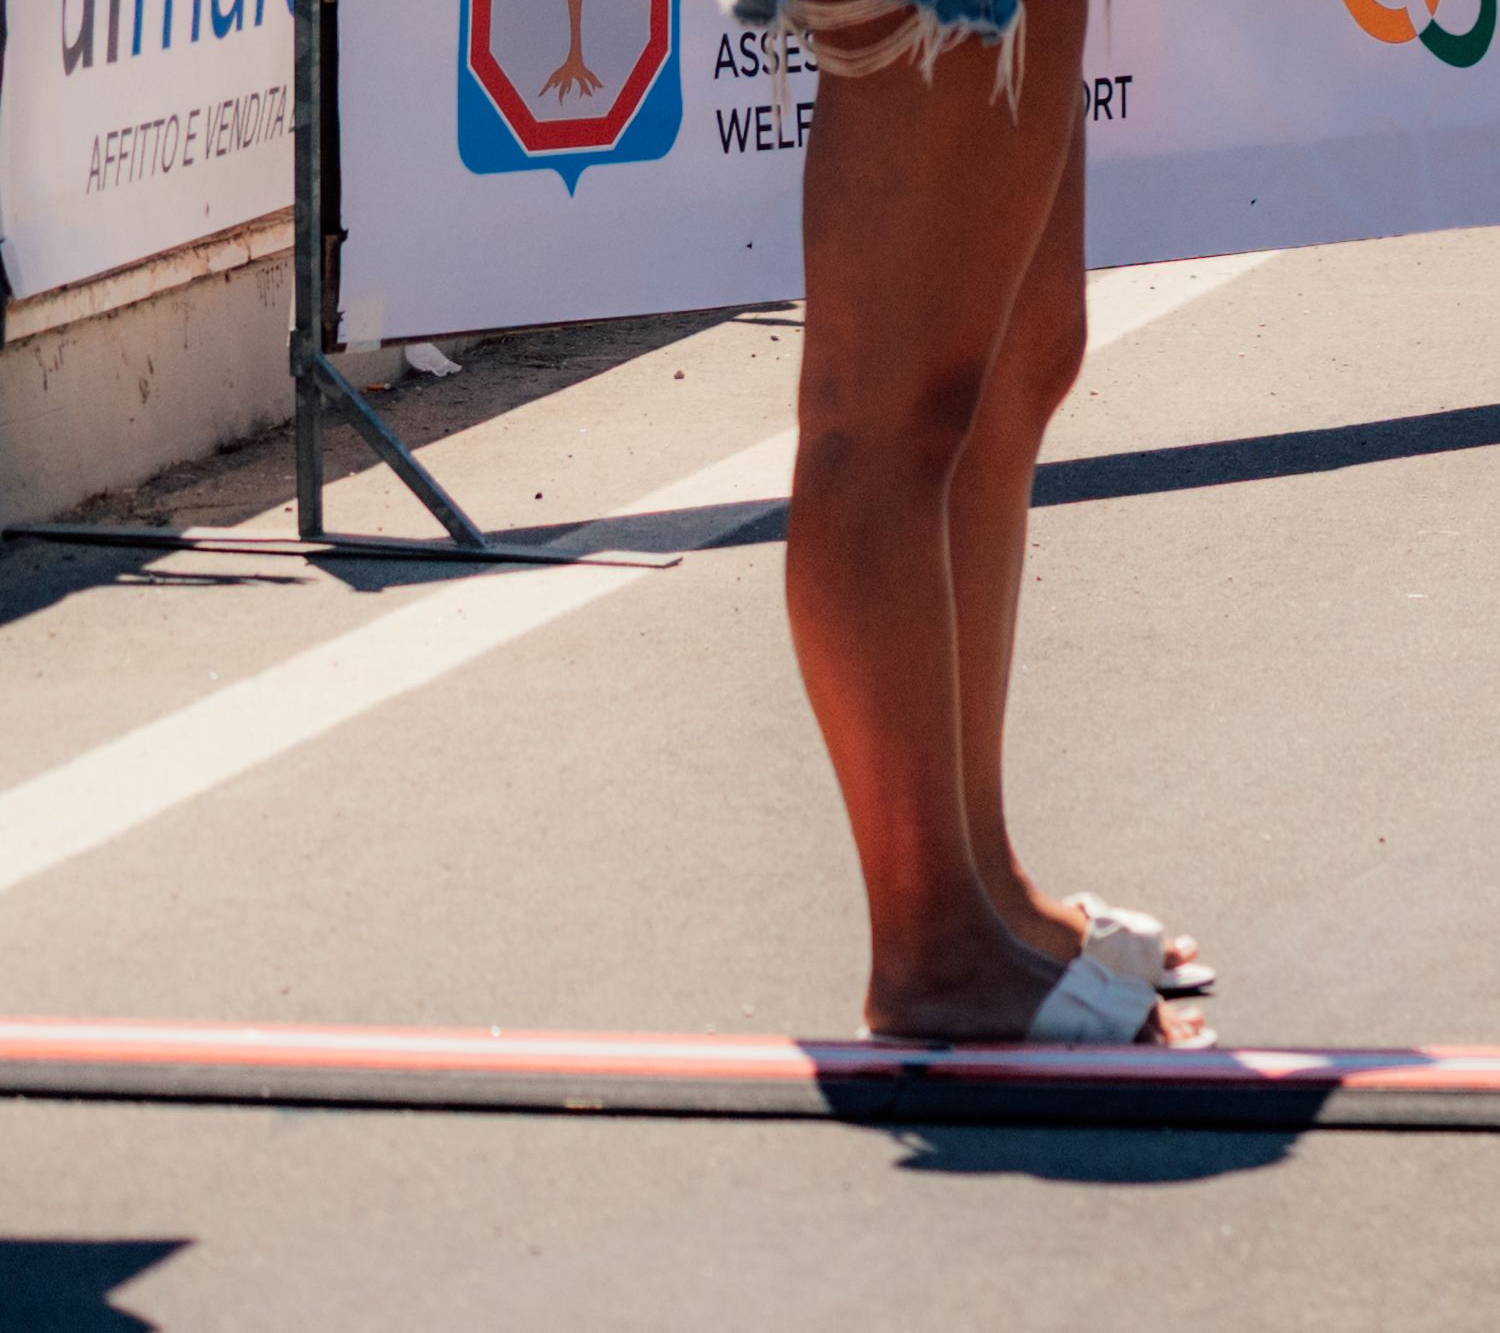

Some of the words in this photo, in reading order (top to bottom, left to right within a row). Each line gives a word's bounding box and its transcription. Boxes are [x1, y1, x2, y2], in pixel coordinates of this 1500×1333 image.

[714, 31, 819, 80] ASSES
[86, 113, 179, 195] AFFITTO
[182, 108, 201, 168] E
[204, 84, 288, 161] VENDITA
[716, 101, 816, 154] WELF
